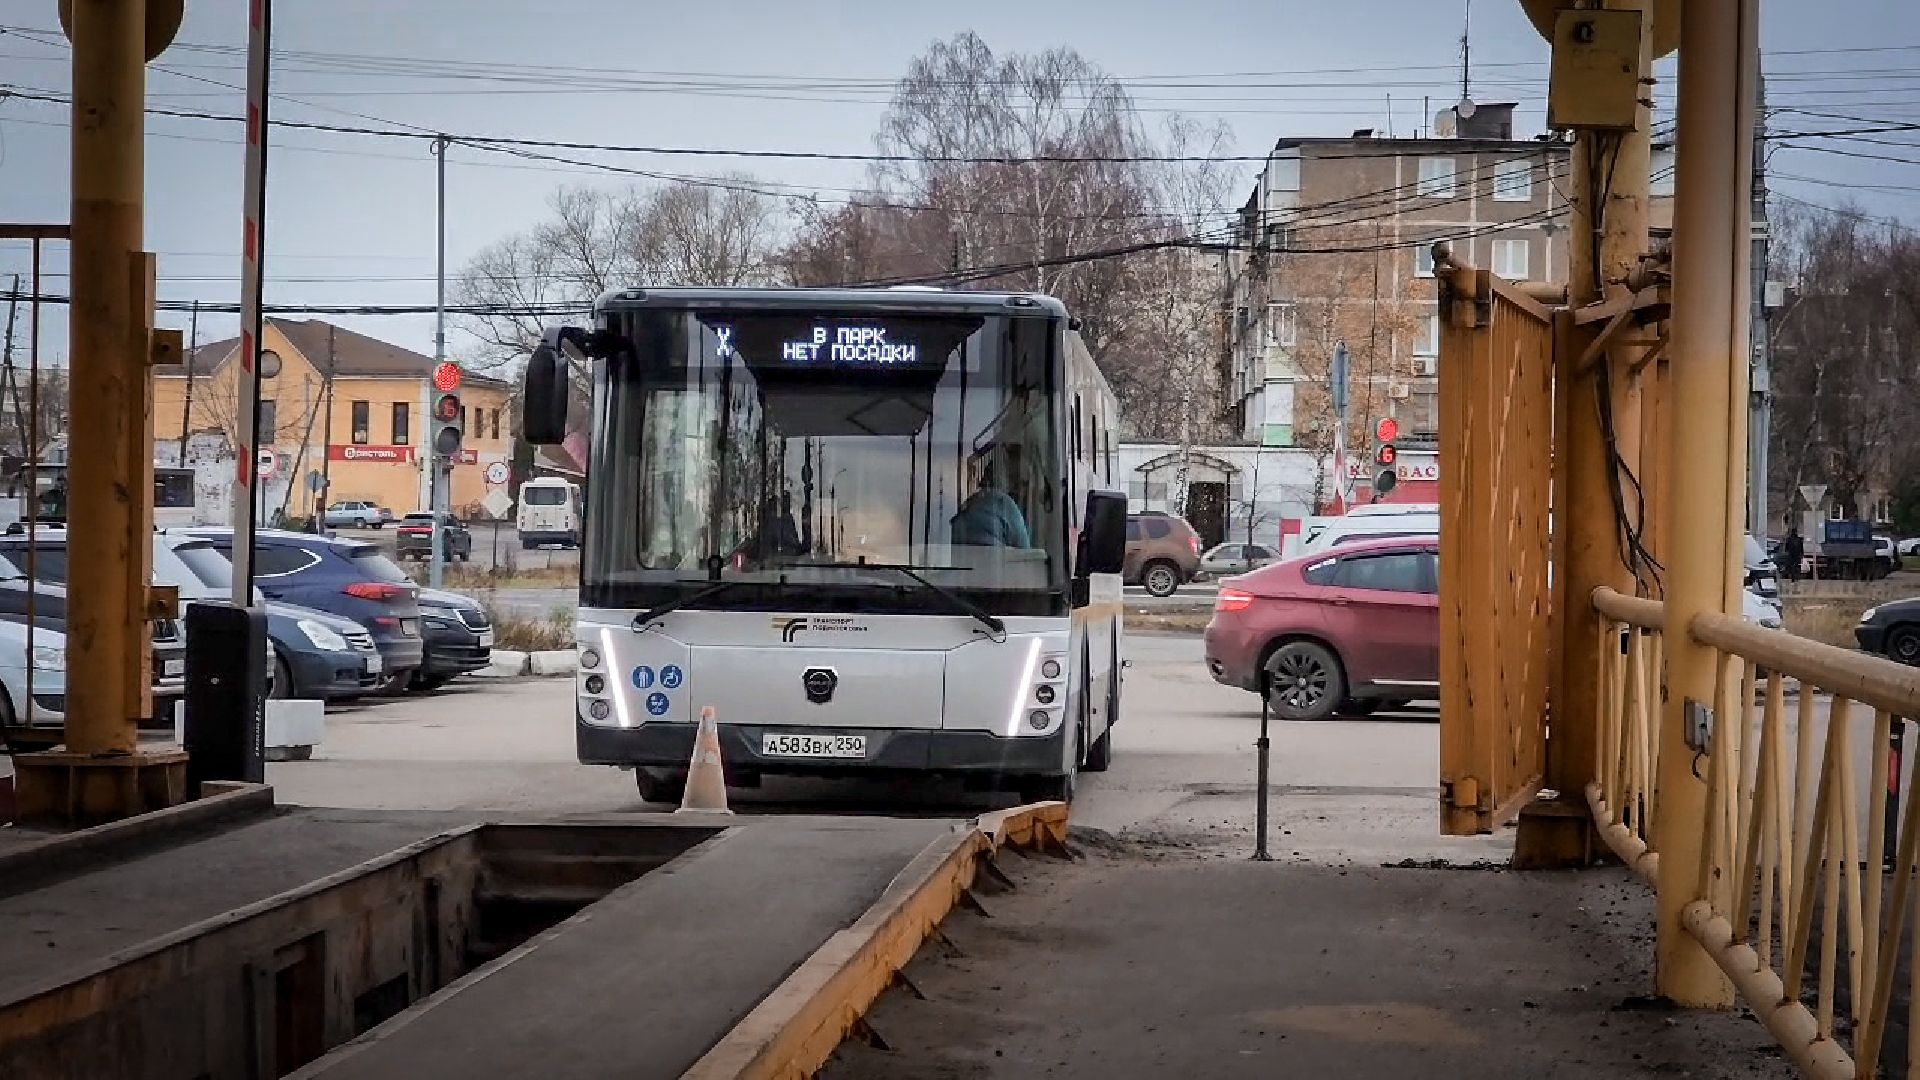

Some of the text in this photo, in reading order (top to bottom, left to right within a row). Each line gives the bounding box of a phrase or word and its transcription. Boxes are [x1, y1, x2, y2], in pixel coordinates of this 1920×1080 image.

[813, 327, 886, 345] В ПАРК
[783, 343, 916, 363] НЕТ ПОСАДКИ
[836, 737, 862, 751] 250
